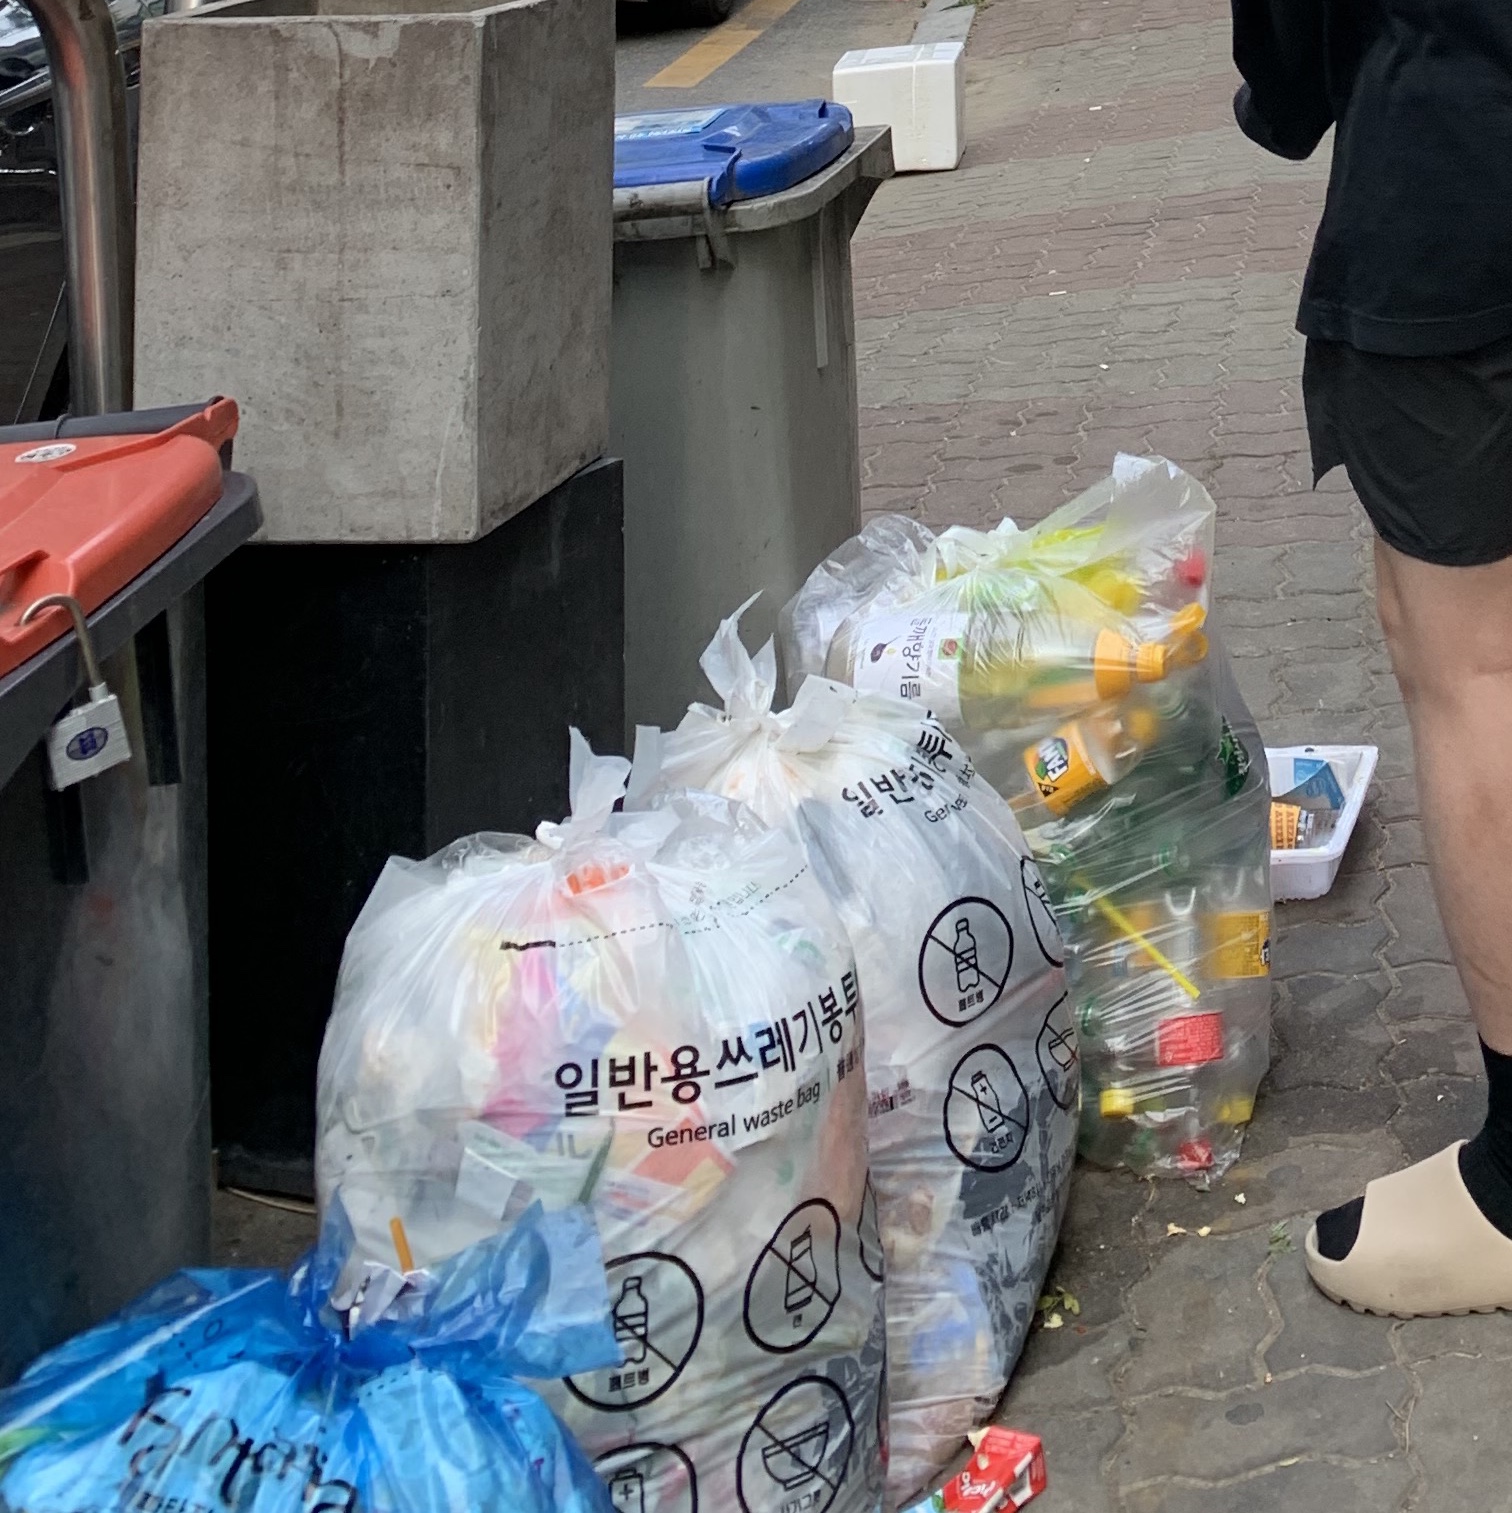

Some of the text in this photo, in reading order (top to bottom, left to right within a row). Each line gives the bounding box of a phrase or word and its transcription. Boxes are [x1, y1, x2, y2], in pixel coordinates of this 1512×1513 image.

[646, 1081, 822, 1150] General waste bag
